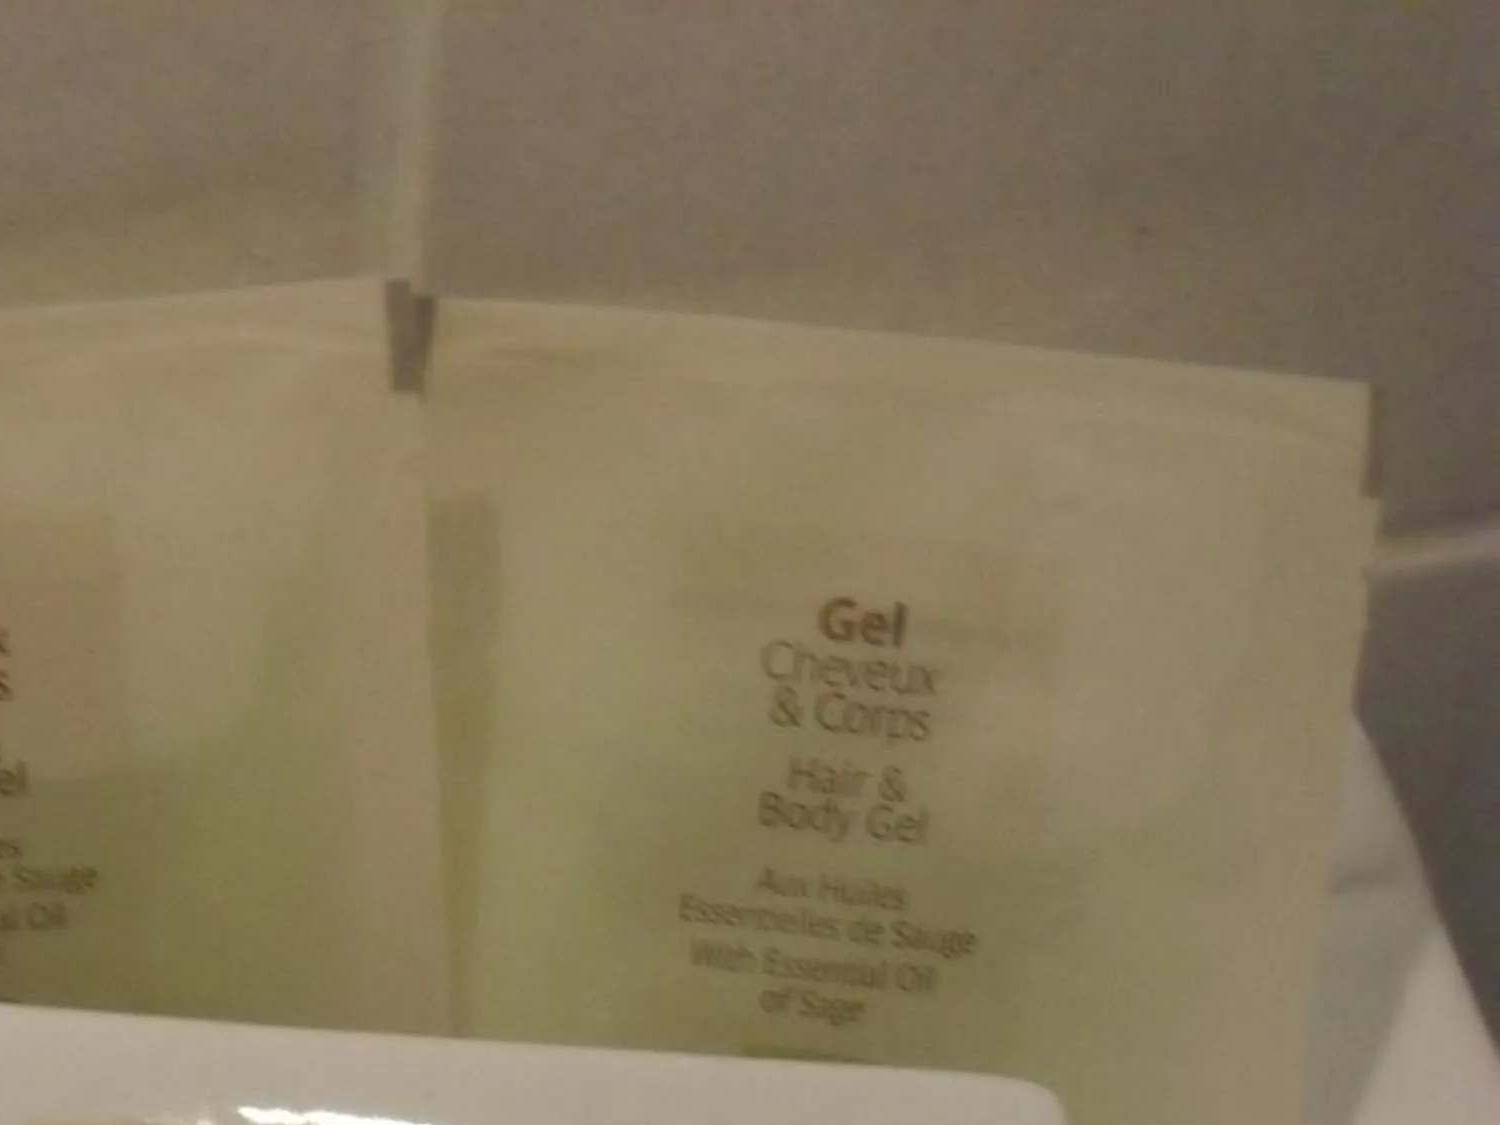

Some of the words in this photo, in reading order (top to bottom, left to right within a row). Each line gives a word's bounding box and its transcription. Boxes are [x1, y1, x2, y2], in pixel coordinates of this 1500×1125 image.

[819, 597, 908, 648] Gel
[761, 639, 937, 695] Cheveux
[767, 685, 801, 728] &
[814, 692, 932, 745] Corps
[787, 758, 874, 795] Hair
[878, 765, 907, 803] &
[759, 791, 848, 841] Body
[866, 803, 929, 844] Gel
